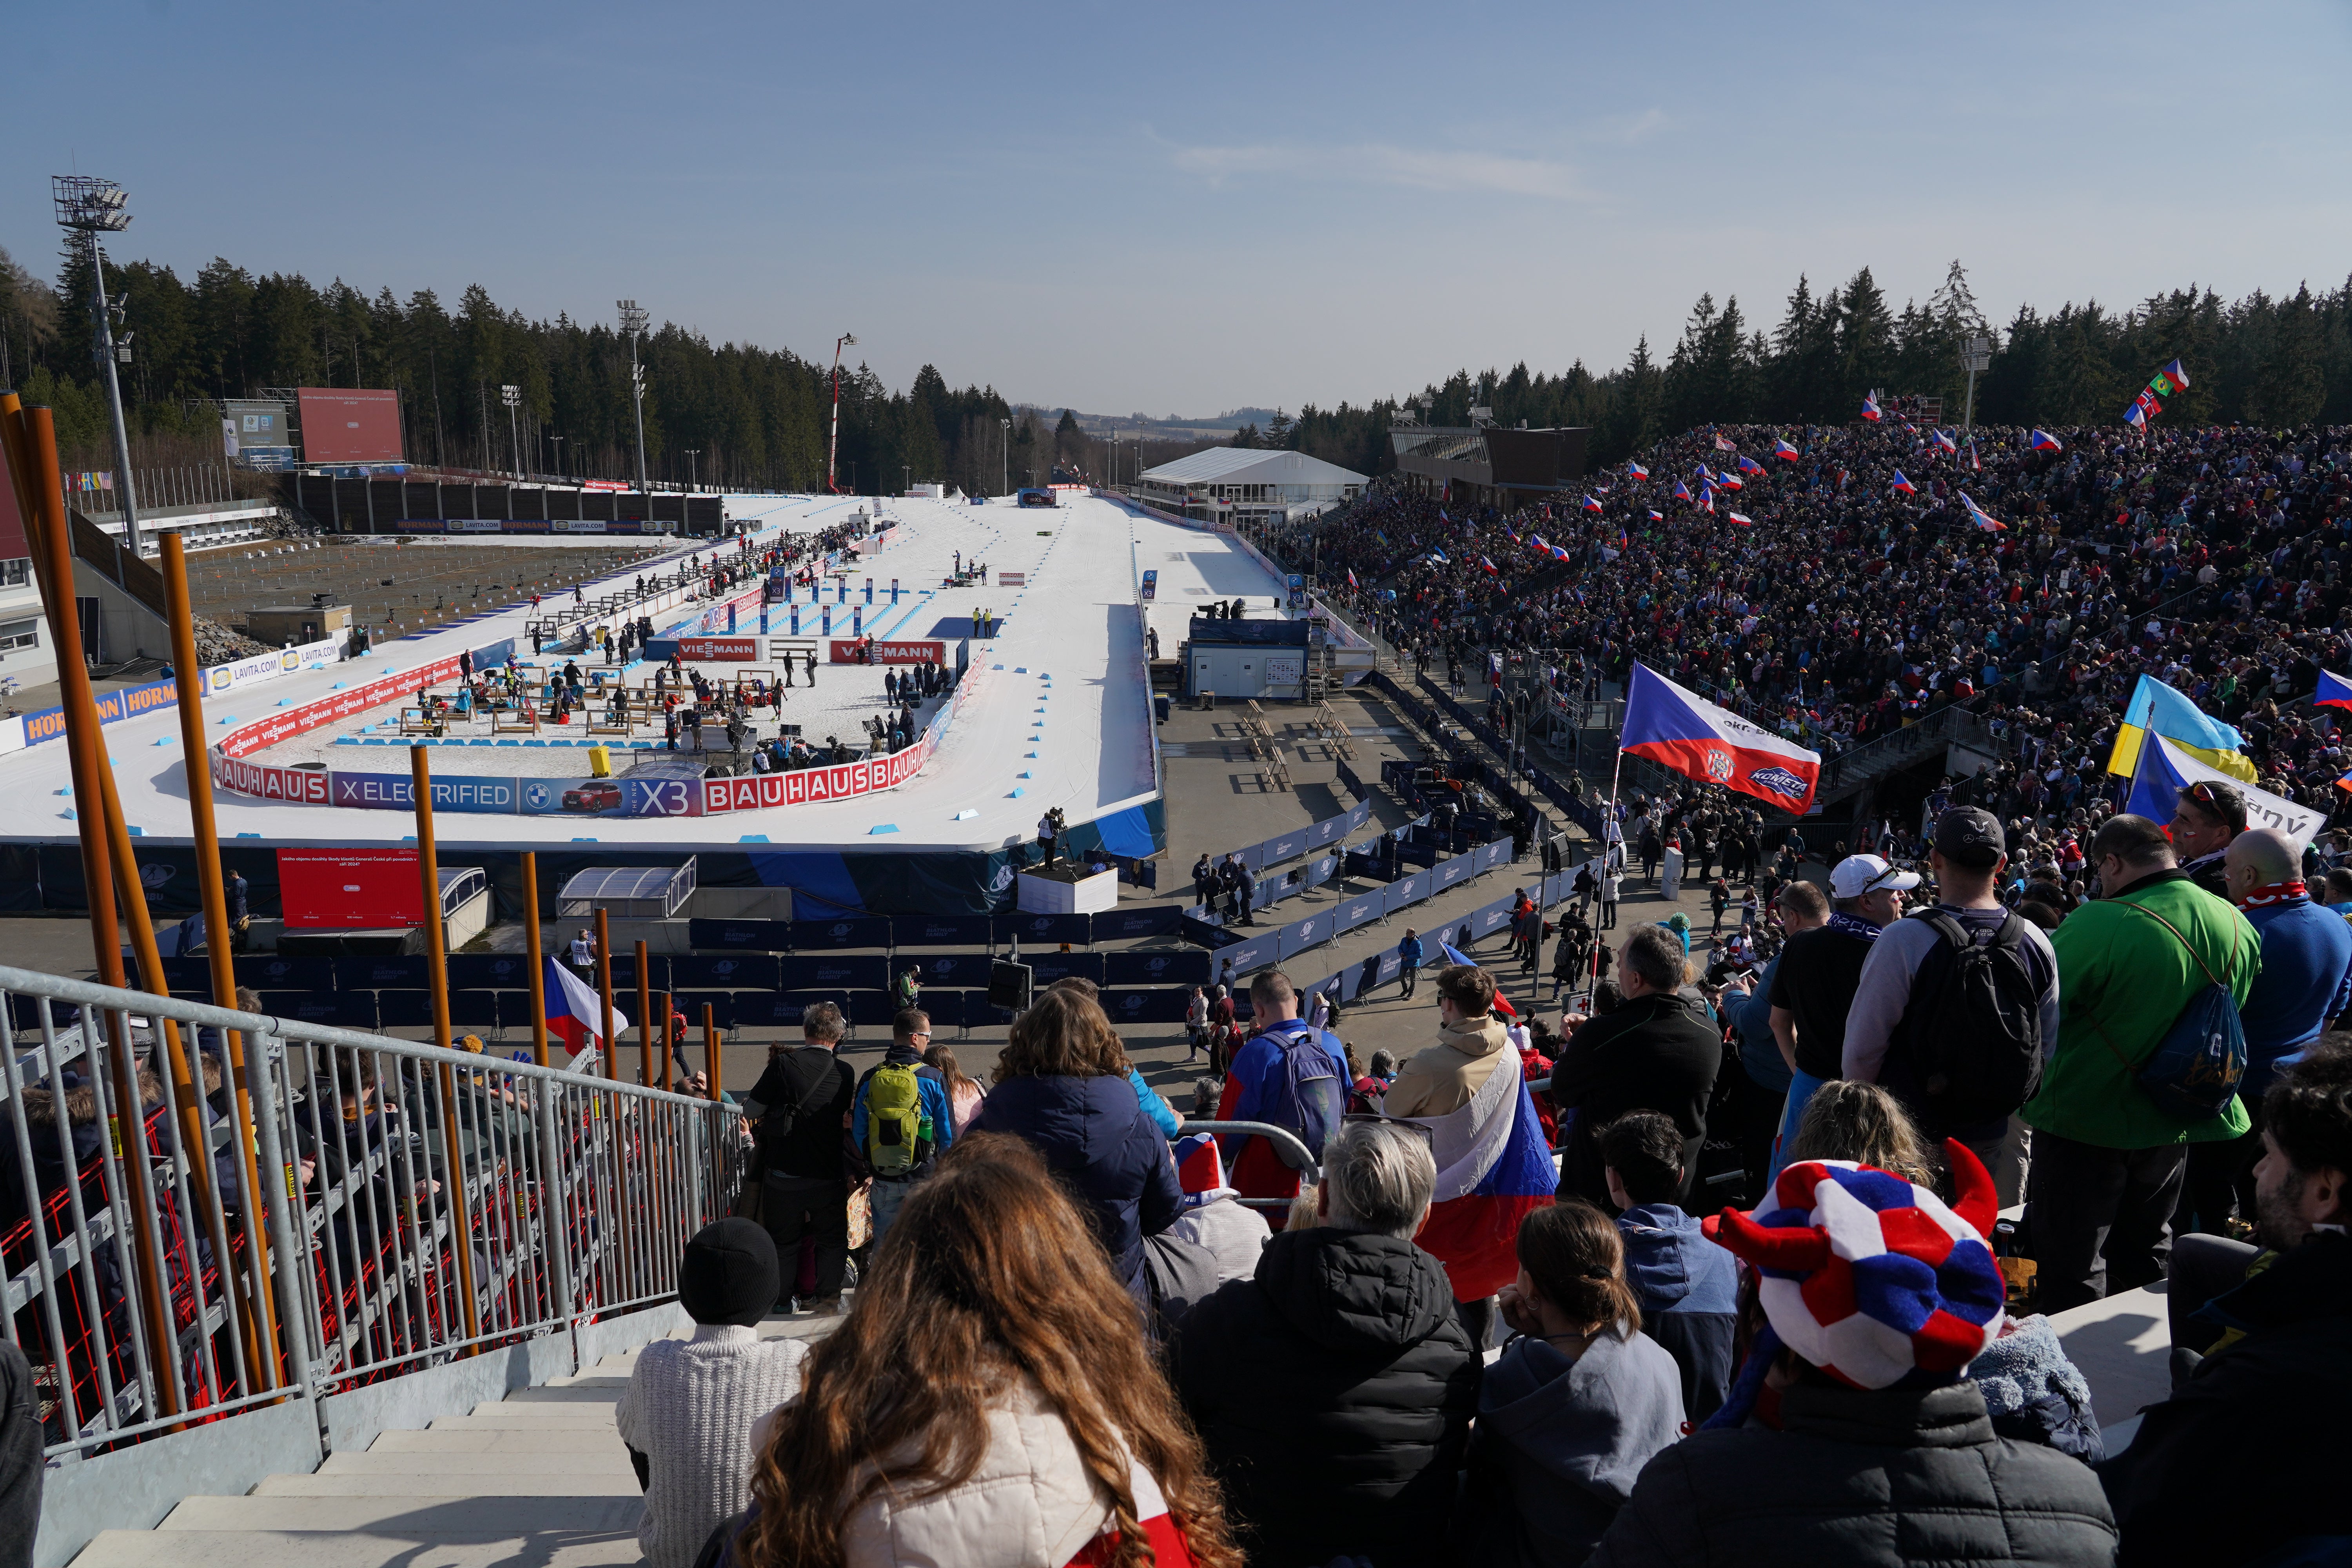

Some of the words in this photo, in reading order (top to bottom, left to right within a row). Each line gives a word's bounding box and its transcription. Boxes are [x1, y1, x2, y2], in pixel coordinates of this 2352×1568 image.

[1209, 522, 1215, 532] X3
[711, 608, 719, 627] X3
[301, 646, 337, 662] LAVITA.COM
[681, 641, 753, 658] VIESSMANN
[841, 643, 933, 663] VSSMANN
[234, 660, 277, 680] LAVITA.COM
[424, 668, 448, 683] VIESSMANN
[397, 677, 422, 693] VIESSMANN
[366, 687, 394, 703] VIESSMANN
[334, 698, 364, 715] VIESSMANN
[299, 708, 332, 727] VIESSMANN
[261, 721, 296, 741] VIESSMANN
[1723, 720, 1750, 732] okr.
[229, 735, 259, 756] VIESSMANN
[1751, 772, 1808, 792] KOMETA
[342, 781, 358, 800] X
[639, 781, 689, 815] X3
[1277, 842, 1292, 852] BIATHLON
[1445, 867, 1459, 876] BIATHLON
[1445, 872, 1455, 881] FAMILY
[998, 892, 1010, 903] IBU
[1351, 912, 1363, 920] FAMILY
[1352, 906, 1368, 916] BIATHLON
[1487, 911, 1503, 922] BIATHLON
[1486, 918, 1499, 926] FAMILY
[1235, 957, 1251, 966] FAMILY
[1236, 950, 1258, 962] BIATHLON
[1383, 958, 1401, 968] BIATHLON
[1382, 965, 1396, 974] FAMILY
